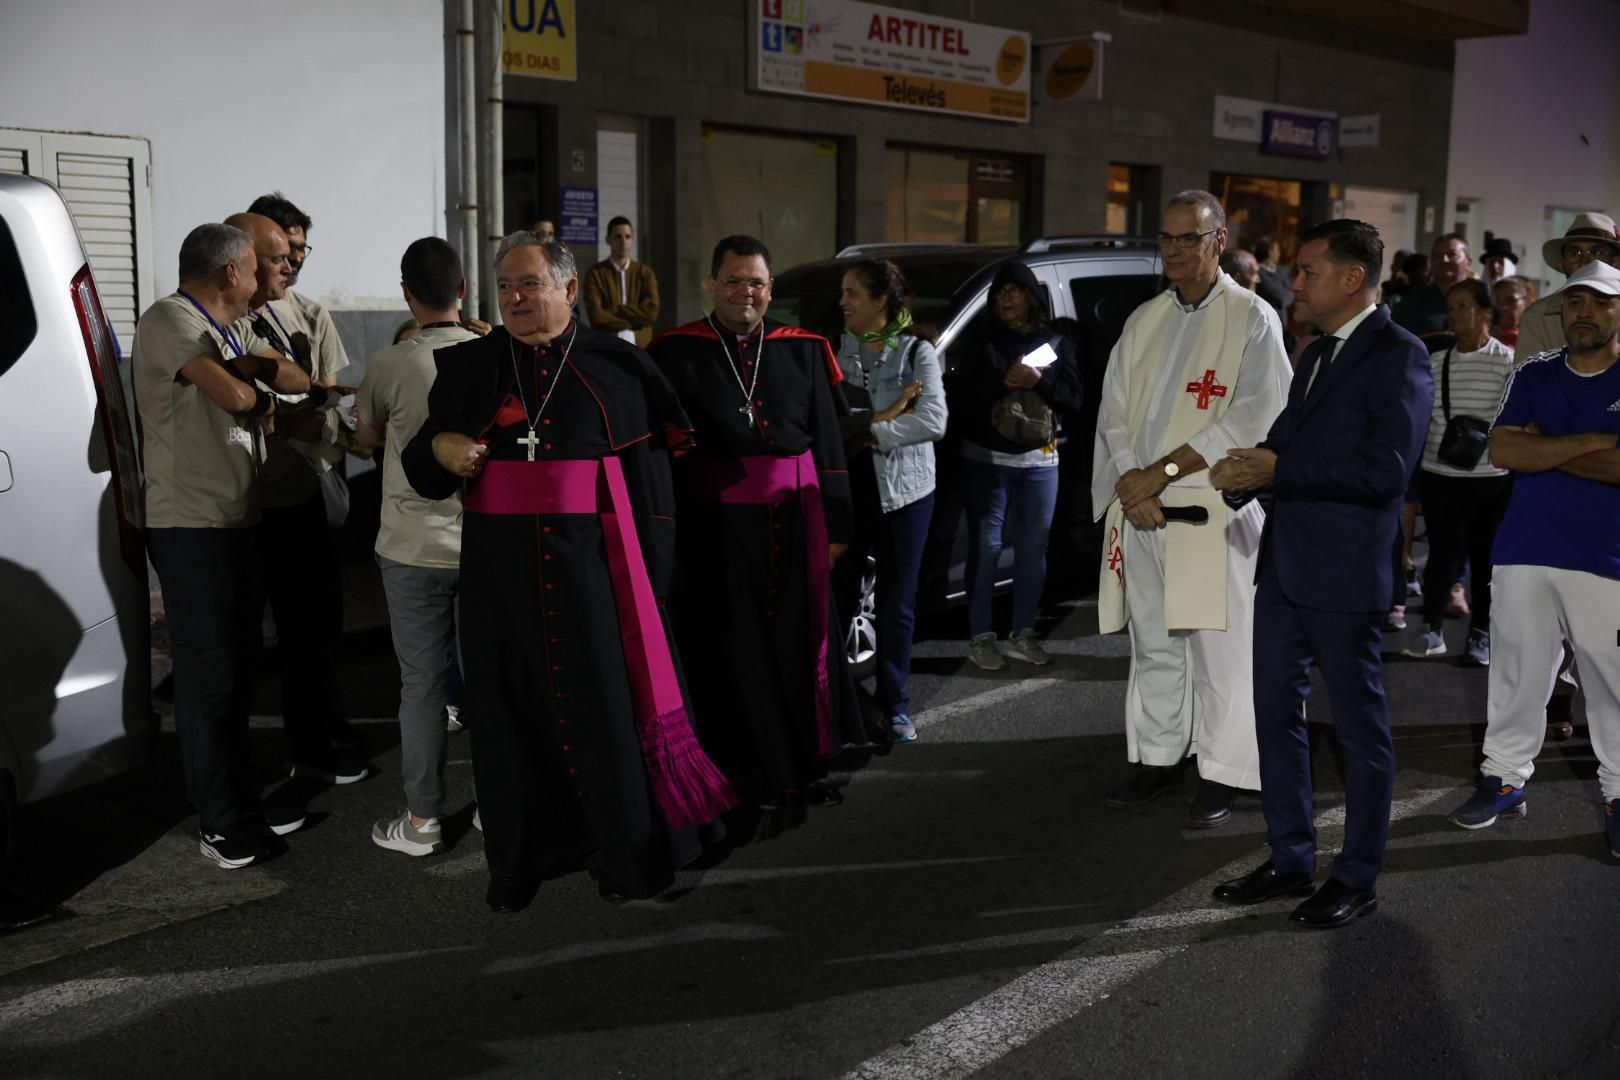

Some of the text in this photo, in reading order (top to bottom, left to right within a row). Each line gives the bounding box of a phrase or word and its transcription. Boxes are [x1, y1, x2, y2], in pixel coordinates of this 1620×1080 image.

[502, 0, 566, 39] UA
[867, 13, 971, 57] ARTITEL
[502, 50, 561, 72] OS DIAS
[882, 75, 946, 108] Televés
[573, 153, 584, 169] 6
